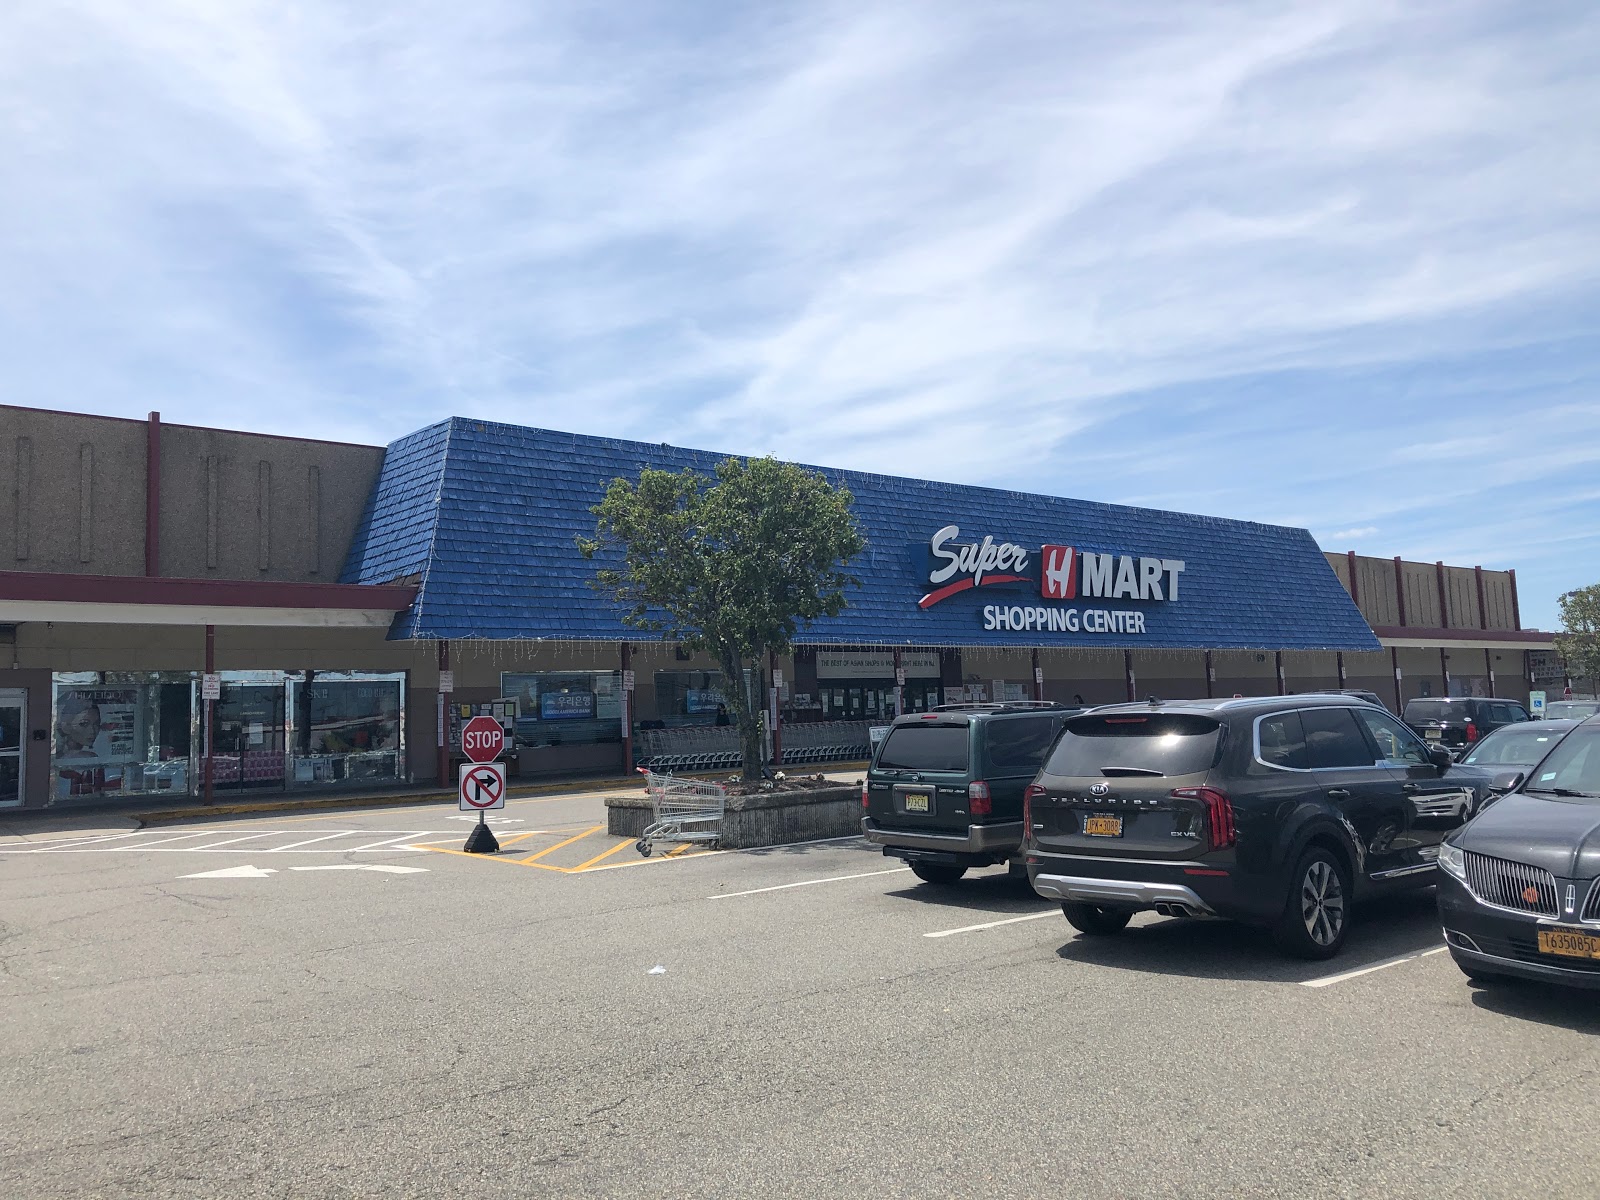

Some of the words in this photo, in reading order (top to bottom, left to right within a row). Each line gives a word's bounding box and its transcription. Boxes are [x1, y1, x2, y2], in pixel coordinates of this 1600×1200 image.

[929, 524, 1029, 586] Super
[1045, 547, 1074, 599] H
[1081, 551, 1186, 602] MART
[983, 605, 1079, 633] SHOPPING
[1082, 609, 1147, 634] CENTER
[821, 659, 830, 667] THE
[831, 659, 842, 667] BEST
[864, 659, 880, 667] SHOPS
[67, 690, 122, 701] SHISEIDO
[557, 695, 591, 707] 우리은행
[465, 730, 502, 749] STOP
[1091, 785, 1106, 793] KIA
[1051, 797, 1158, 806] TELLURIDE
[1543, 932, 1599, 953] T635085C
